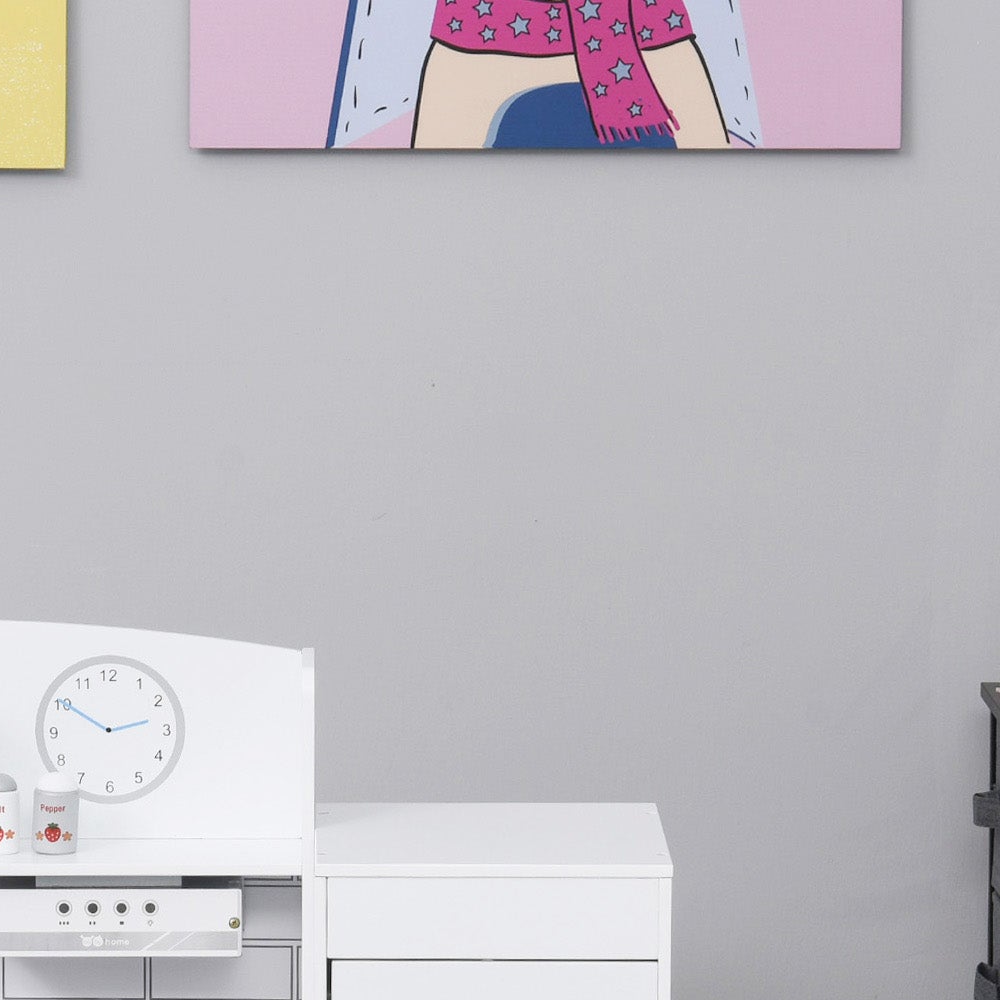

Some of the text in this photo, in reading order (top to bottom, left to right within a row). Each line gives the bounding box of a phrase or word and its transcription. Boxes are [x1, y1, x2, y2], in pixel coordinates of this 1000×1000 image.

[100, 669, 118, 682] 12
[75, 678, 90, 690] 11
[136, 678, 142, 690] 1
[54, 698, 72, 711] 10
[154, 695, 163, 707] 2
[49, 727, 59, 739] 9
[162, 724, 171, 737] 3
[57, 754, 66, 766] 8
[154, 750, 163, 762] 4
[77, 772, 86, 785] 7
[134, 772, 143, 784] 5
[105, 781, 114, 793] 6
[40, 803, 66, 814] Pepper
